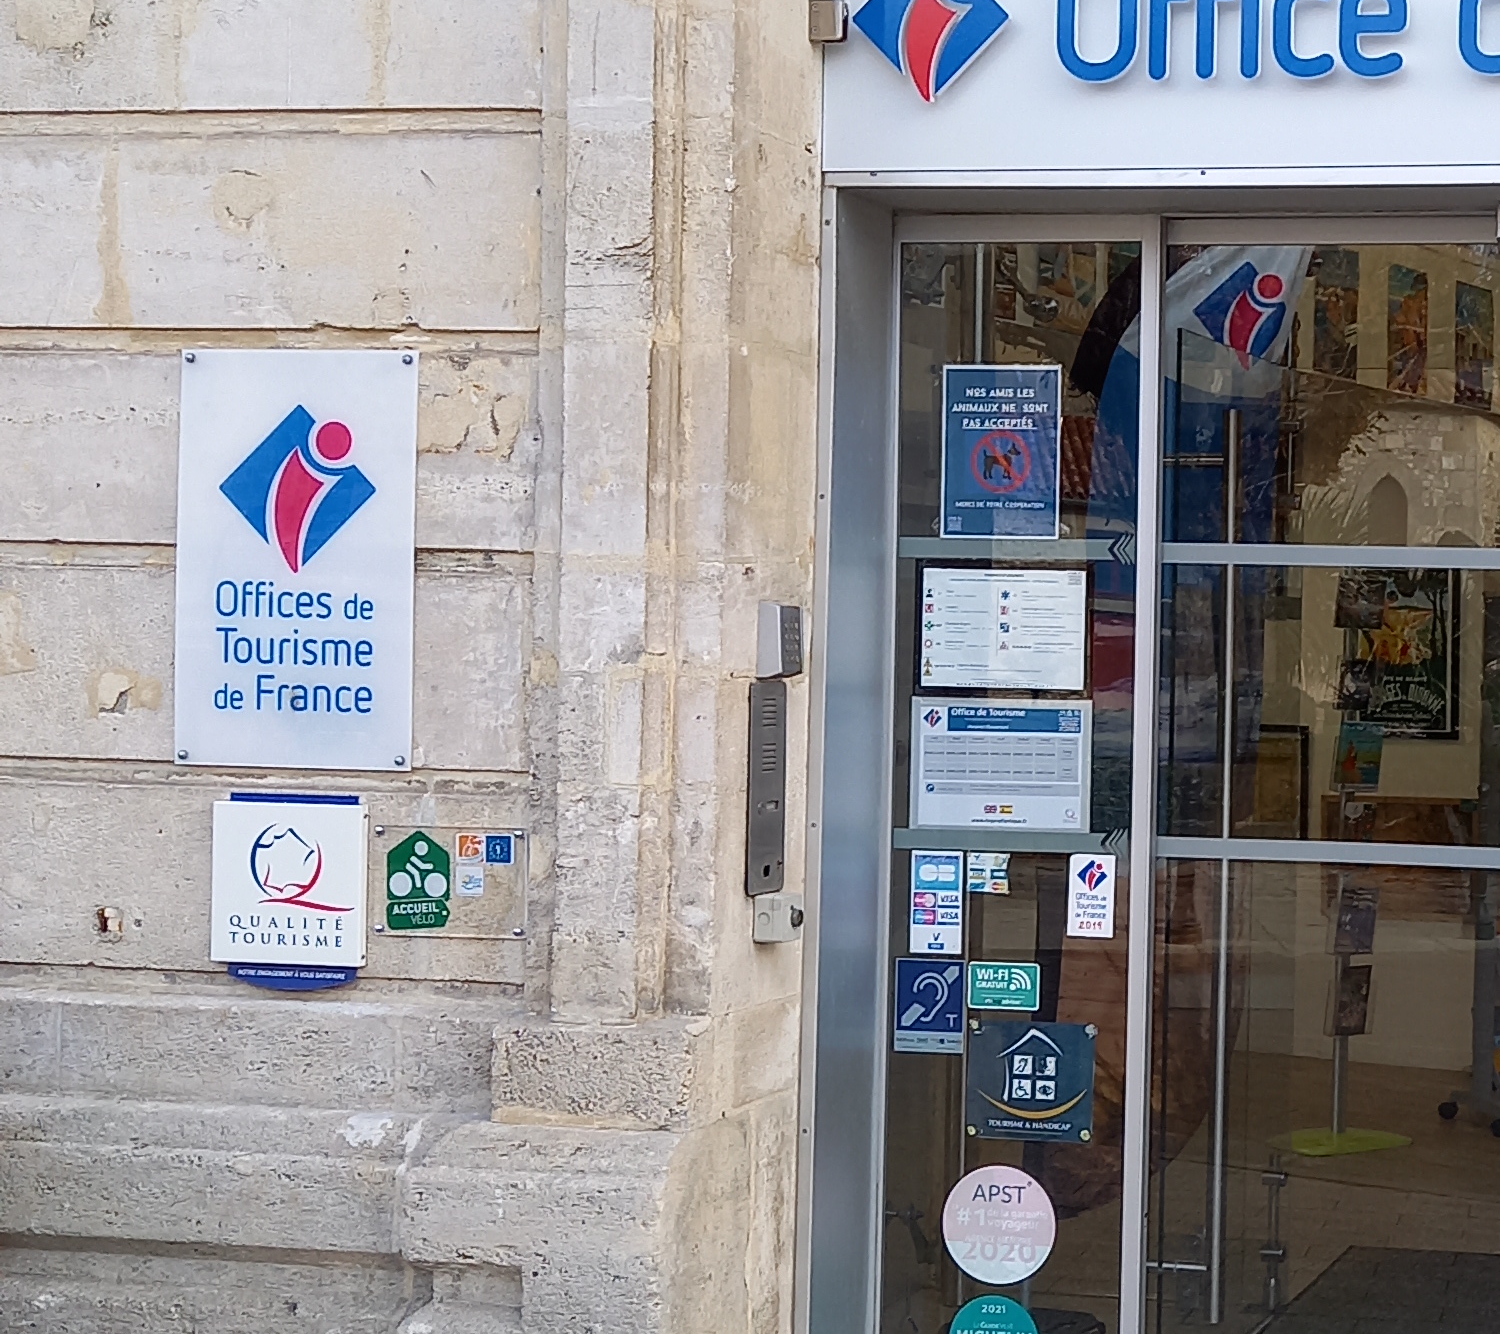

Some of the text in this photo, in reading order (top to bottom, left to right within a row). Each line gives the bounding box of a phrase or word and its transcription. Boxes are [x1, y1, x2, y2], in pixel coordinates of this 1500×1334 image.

[966, 388, 1035, 397] NOS AMIS LES
[952, 403, 1048, 413] ANIMAUX NE SONT
[963, 416, 1033, 428] PAS ACCEPTÉS
[216, 580, 374, 620] Offices de
[216, 627, 373, 666] Tourisme
[214, 674, 373, 713] de France
[951, 708, 975, 716] Office
[989, 709, 1026, 717] Tourisme
[940, 895, 959, 903] VISA
[1076, 893, 1099, 901] Offices
[392, 902, 440, 915] ACCUEIL
[1076, 901, 1107, 910] Tourisme
[939, 912, 959, 920] VISA
[1083, 911, 1106, 919] France
[229, 914, 343, 930] QUALITÉ
[229, 931, 343, 947] TOURISME
[976, 968, 1009, 980] WI-FI
[976, 980, 1008, 988] GRATUIT
[945, 1014, 958, 1027] T
[988, 1119, 1023, 1127] TOURISME
[972, 1184, 1026, 1204] APST
[957, 1207, 985, 1226] #1
[987, 1219, 1039, 1231] voyageur
[962, 1240, 1036, 1264] 2020
[981, 1304, 1006, 1313] 2021
